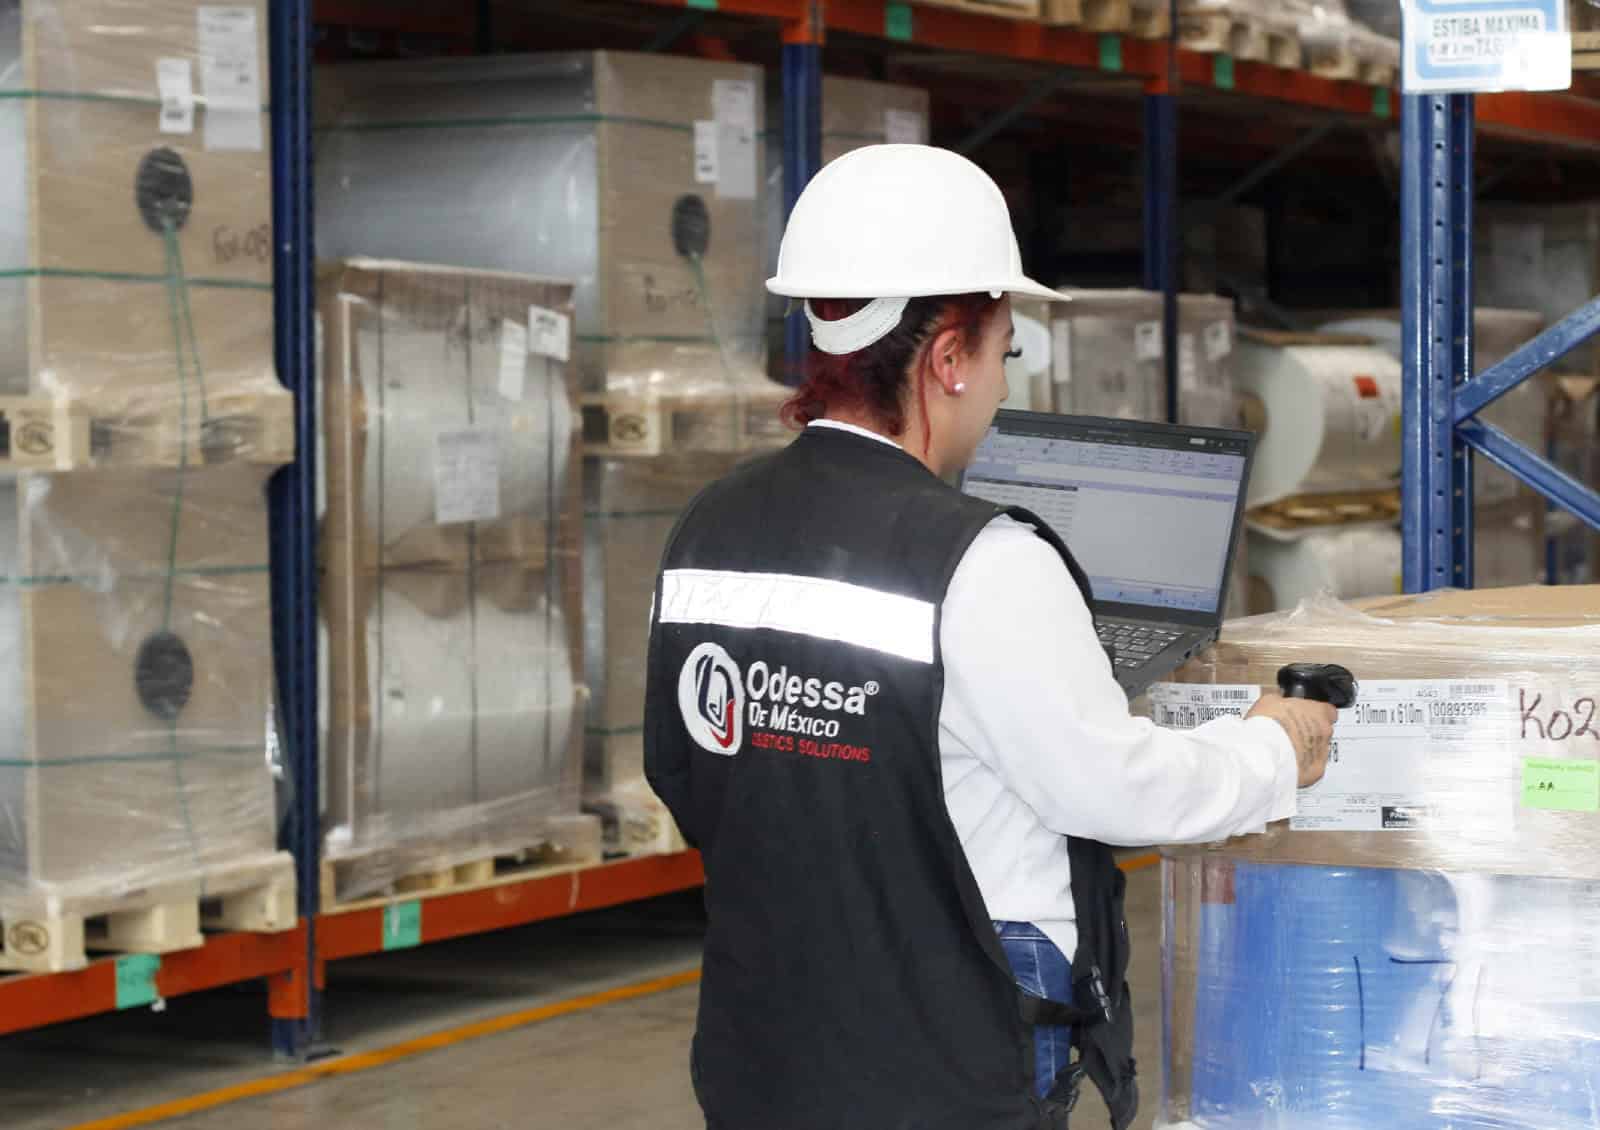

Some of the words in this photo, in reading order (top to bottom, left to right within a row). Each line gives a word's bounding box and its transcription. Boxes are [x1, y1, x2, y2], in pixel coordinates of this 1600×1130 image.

[1432, 17, 1481, 38] ESTIBA
[770, 704, 840, 737] MÉXICO
[798, 738, 871, 763] SOLUTIONS
